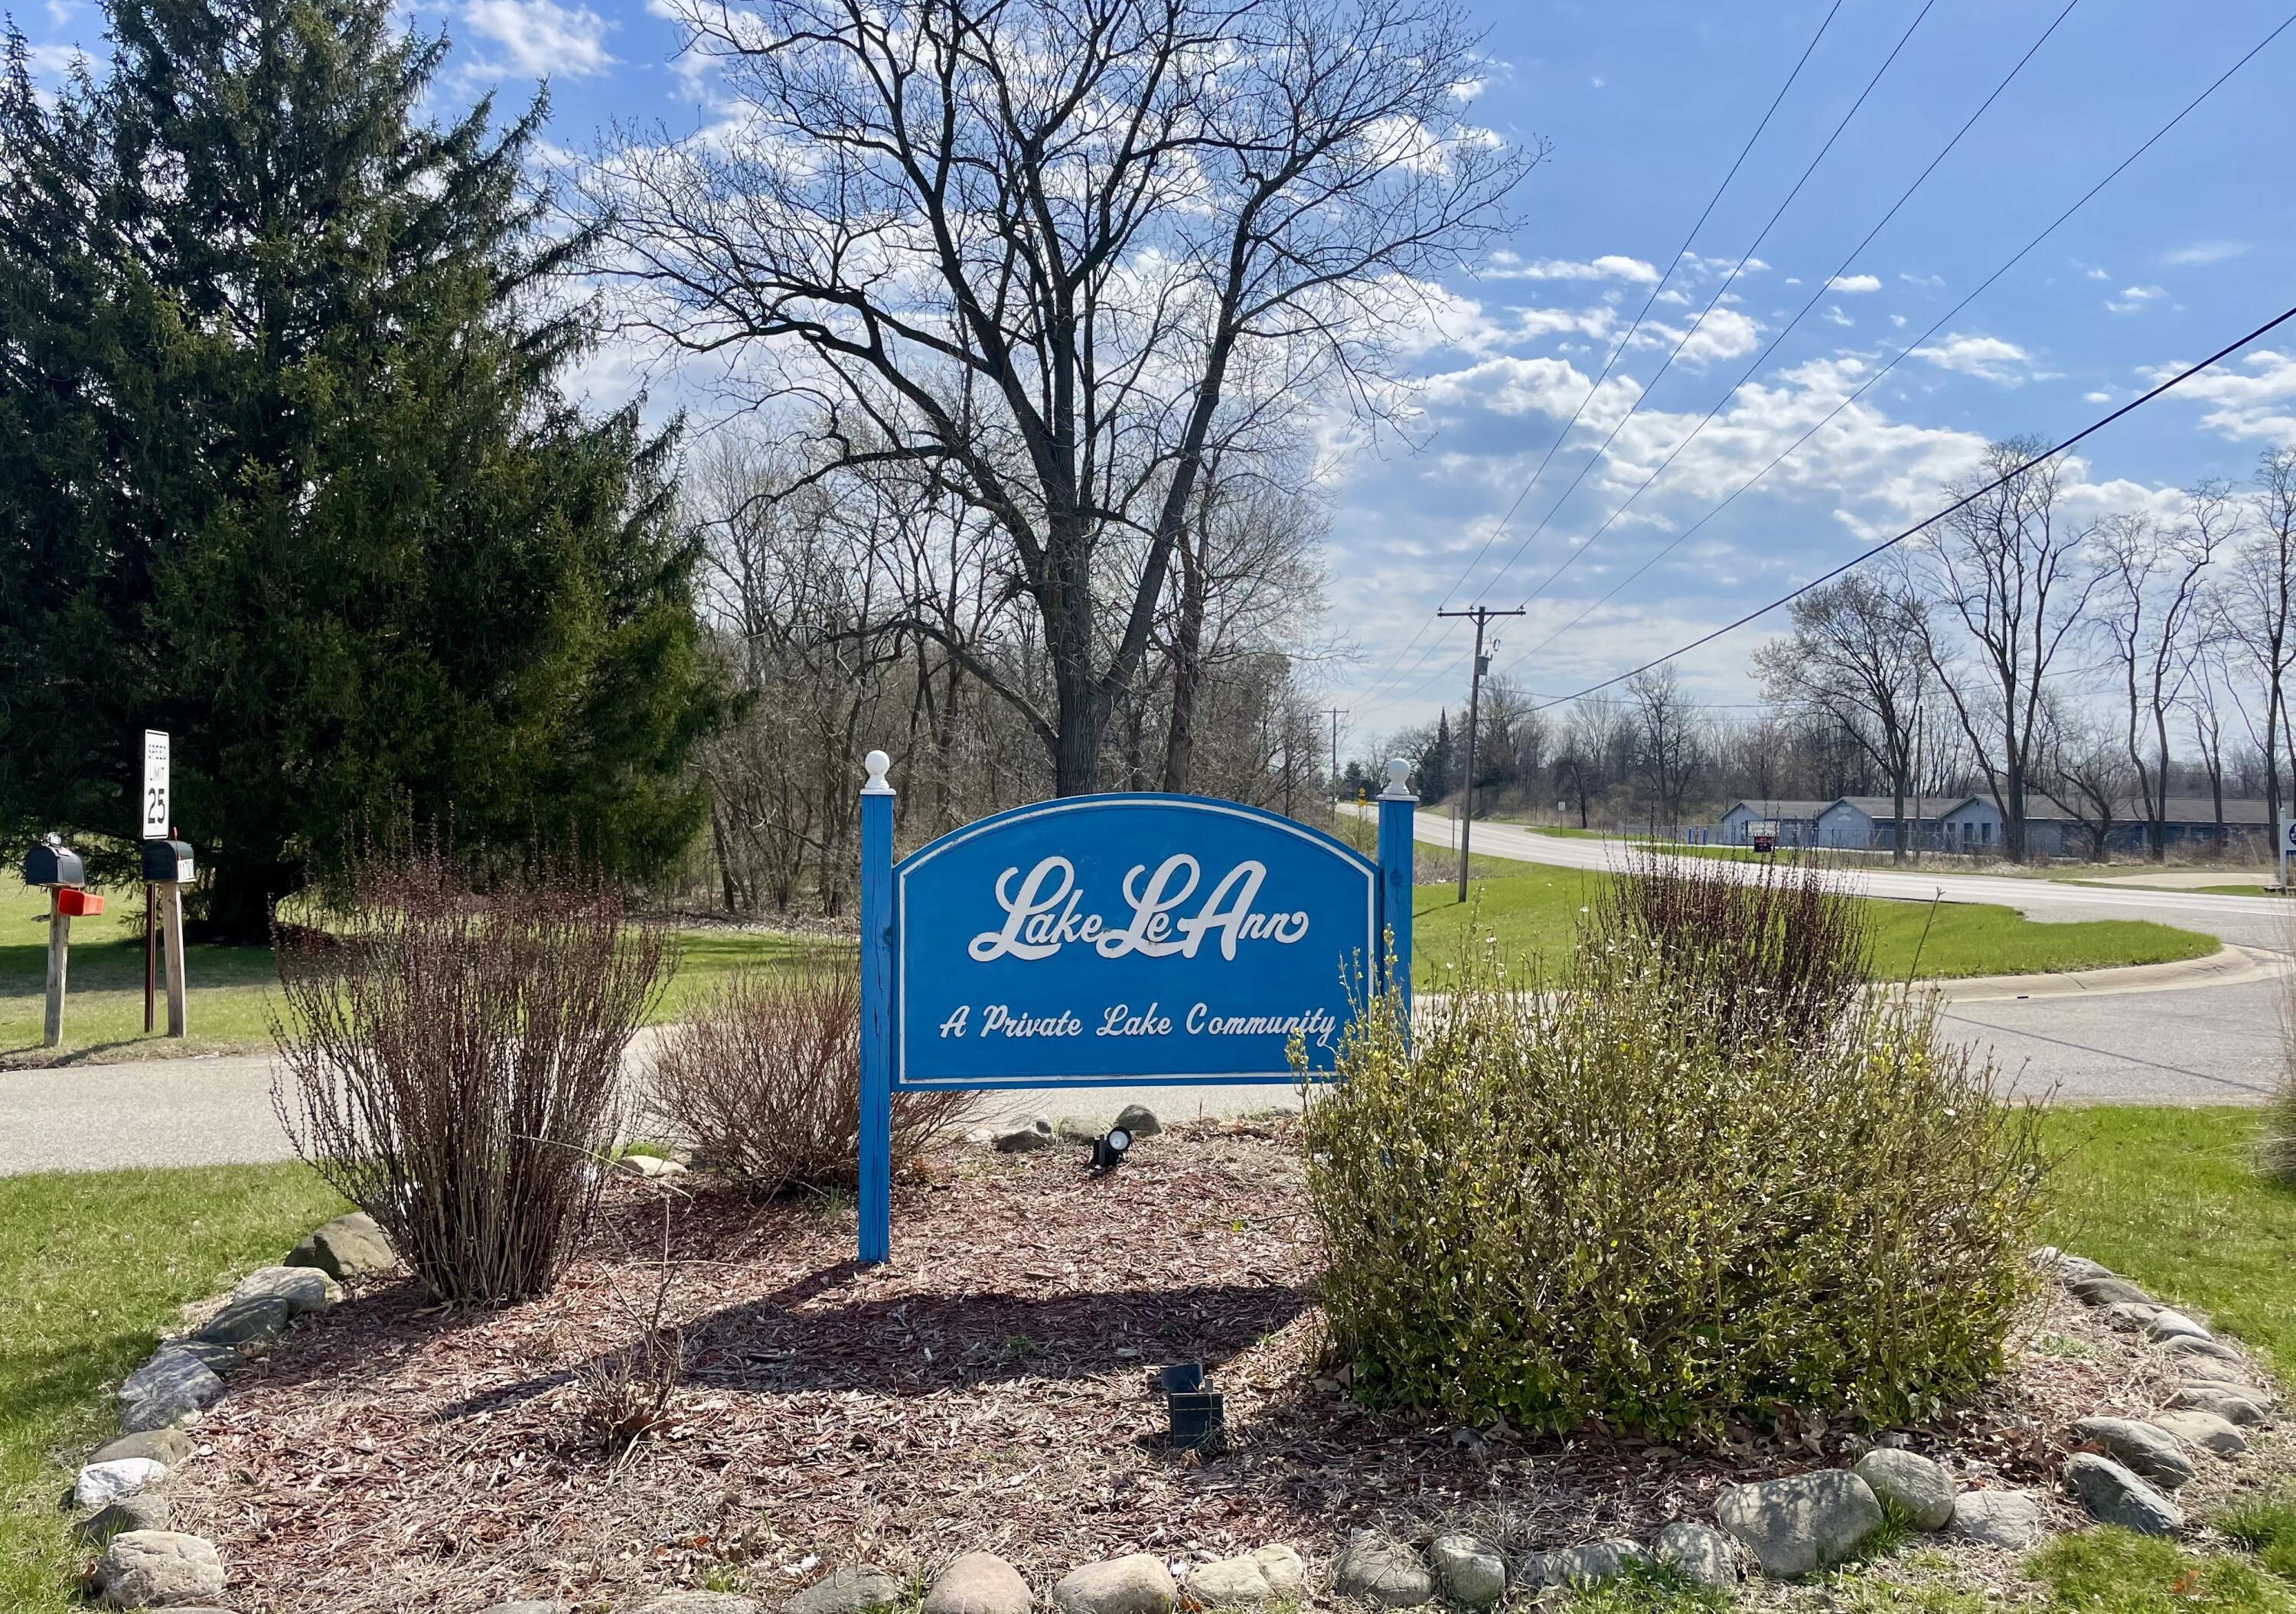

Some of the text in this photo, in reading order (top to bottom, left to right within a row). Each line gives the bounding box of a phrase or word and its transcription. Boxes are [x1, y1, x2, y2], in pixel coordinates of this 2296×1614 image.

[148, 744, 167, 760] SPEED
[148, 787, 165, 824] 25
[967, 853, 1309, 962] Lake Le Ann
[940, 1003, 1336, 1047] A Private Lake Community
